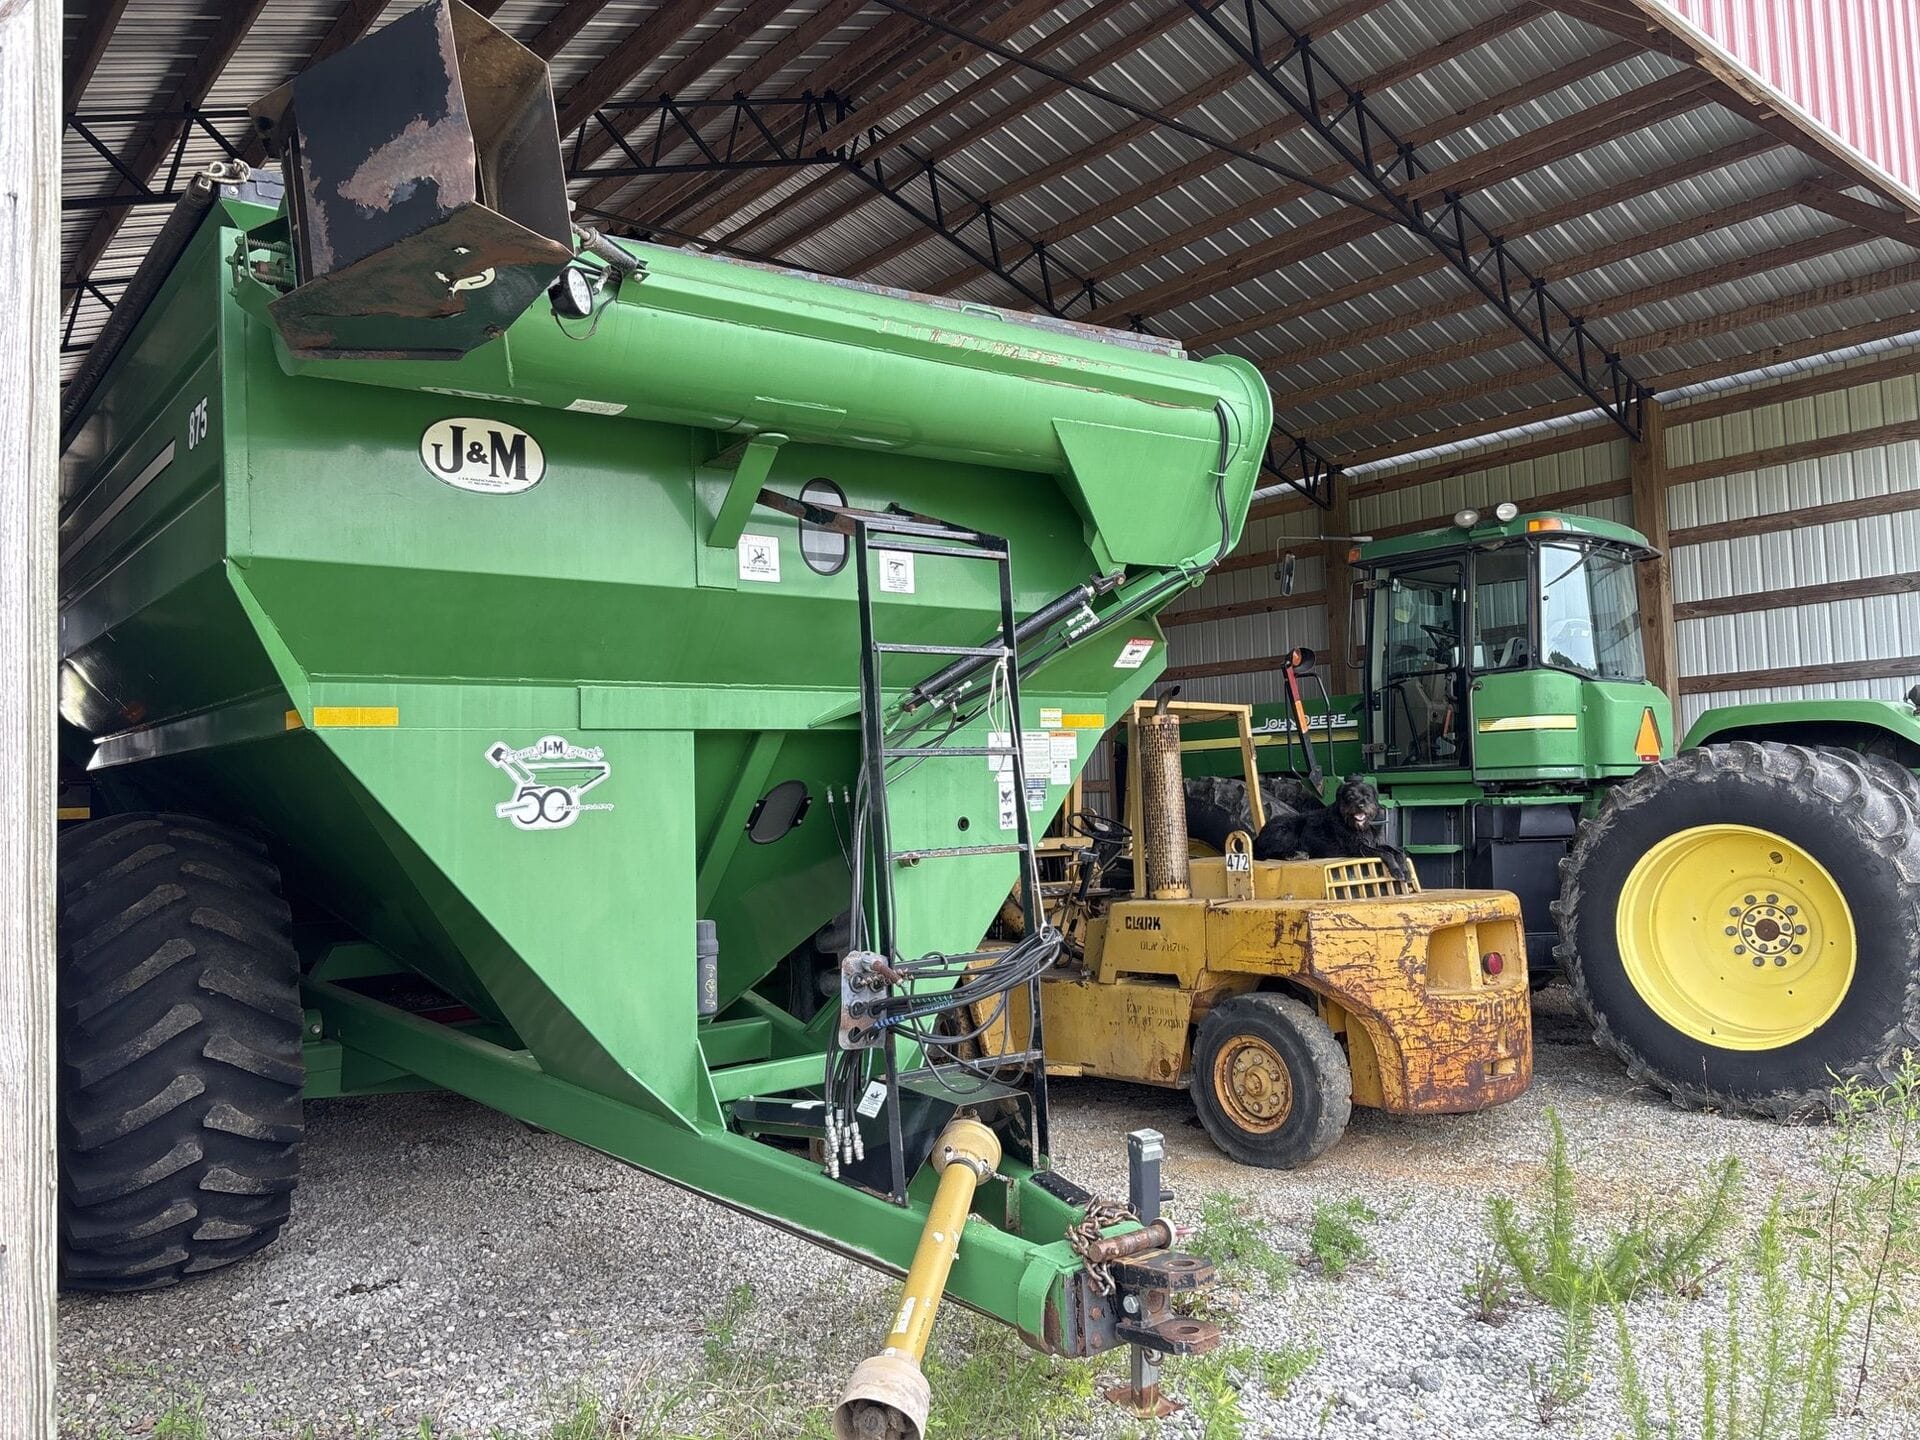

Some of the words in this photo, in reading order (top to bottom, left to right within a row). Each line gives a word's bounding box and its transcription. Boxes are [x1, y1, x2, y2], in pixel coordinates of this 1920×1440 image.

[188, 396, 208, 450] 875
[431, 425, 529, 481] J&M
[542, 741, 563, 754] J&M
[517, 785, 573, 824] 50
[1227, 855, 1248, 870] 472
[1125, 916, 1161, 931] CLARK
